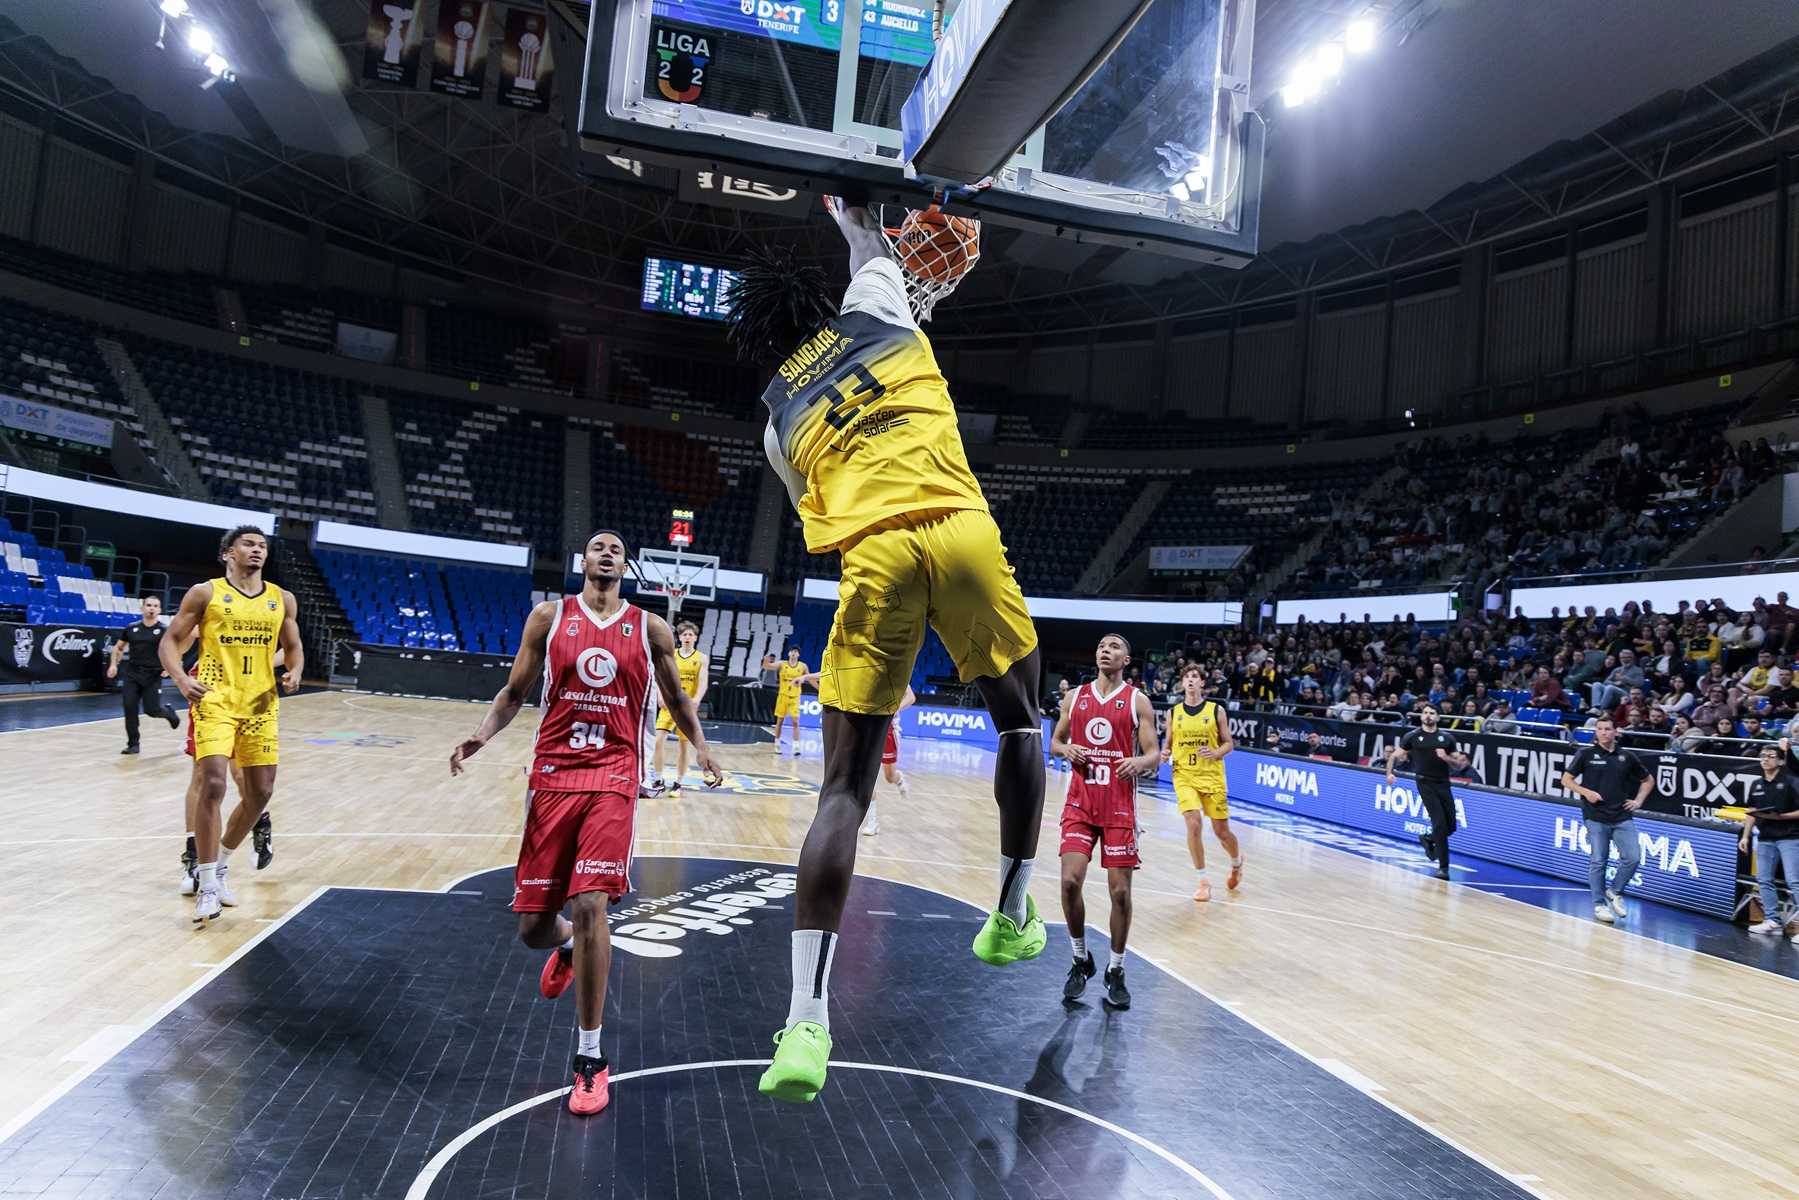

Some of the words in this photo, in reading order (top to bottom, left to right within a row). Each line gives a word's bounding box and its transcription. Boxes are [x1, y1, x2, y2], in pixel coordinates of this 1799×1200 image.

[757, 0, 806, 24] DXT
[826, 0, 839, 23] 3
[863, 10, 876, 23] 43
[880, 15, 919, 32] AUCIELLO
[756, 18, 800, 34] TENERIFE
[656, 29, 710, 57] LIGA
[778, 326, 840, 383] SANGARE
[785, 336, 854, 400] HOVIMA
[813, 362, 835, 382] HOTELS
[15, 403, 49, 420] DXT
[852, 409, 896, 431] yasten
[863, 421, 891, 439] solar
[672, 521, 690, 535] 21
[53, 634, 96, 658] Balmes
[242, 655, 253, 675] 11
[558, 687, 628, 708] Casademont
[573, 703, 611, 714] ZARAGOZA
[917, 711, 987, 730] HOVIMA
[1228, 717, 1259, 739] DXT
[568, 721, 606, 750] 34
[1266, 725, 1299, 741] Pbellón
[1319, 735, 1348, 748] portes
[1188, 753, 1197, 766] 13
[1085, 763, 1111, 786] 10
[1255, 762, 1319, 797] HOVIMA
[1496, 746, 1583, 800] TENER
[1682, 768, 1762, 806] DXT
[1275, 792, 1295, 805] HOTELS
[584, 859, 617, 869] Zaragoza
[692, 867, 773, 893] despierta
[606, 890, 695, 925] emocion
